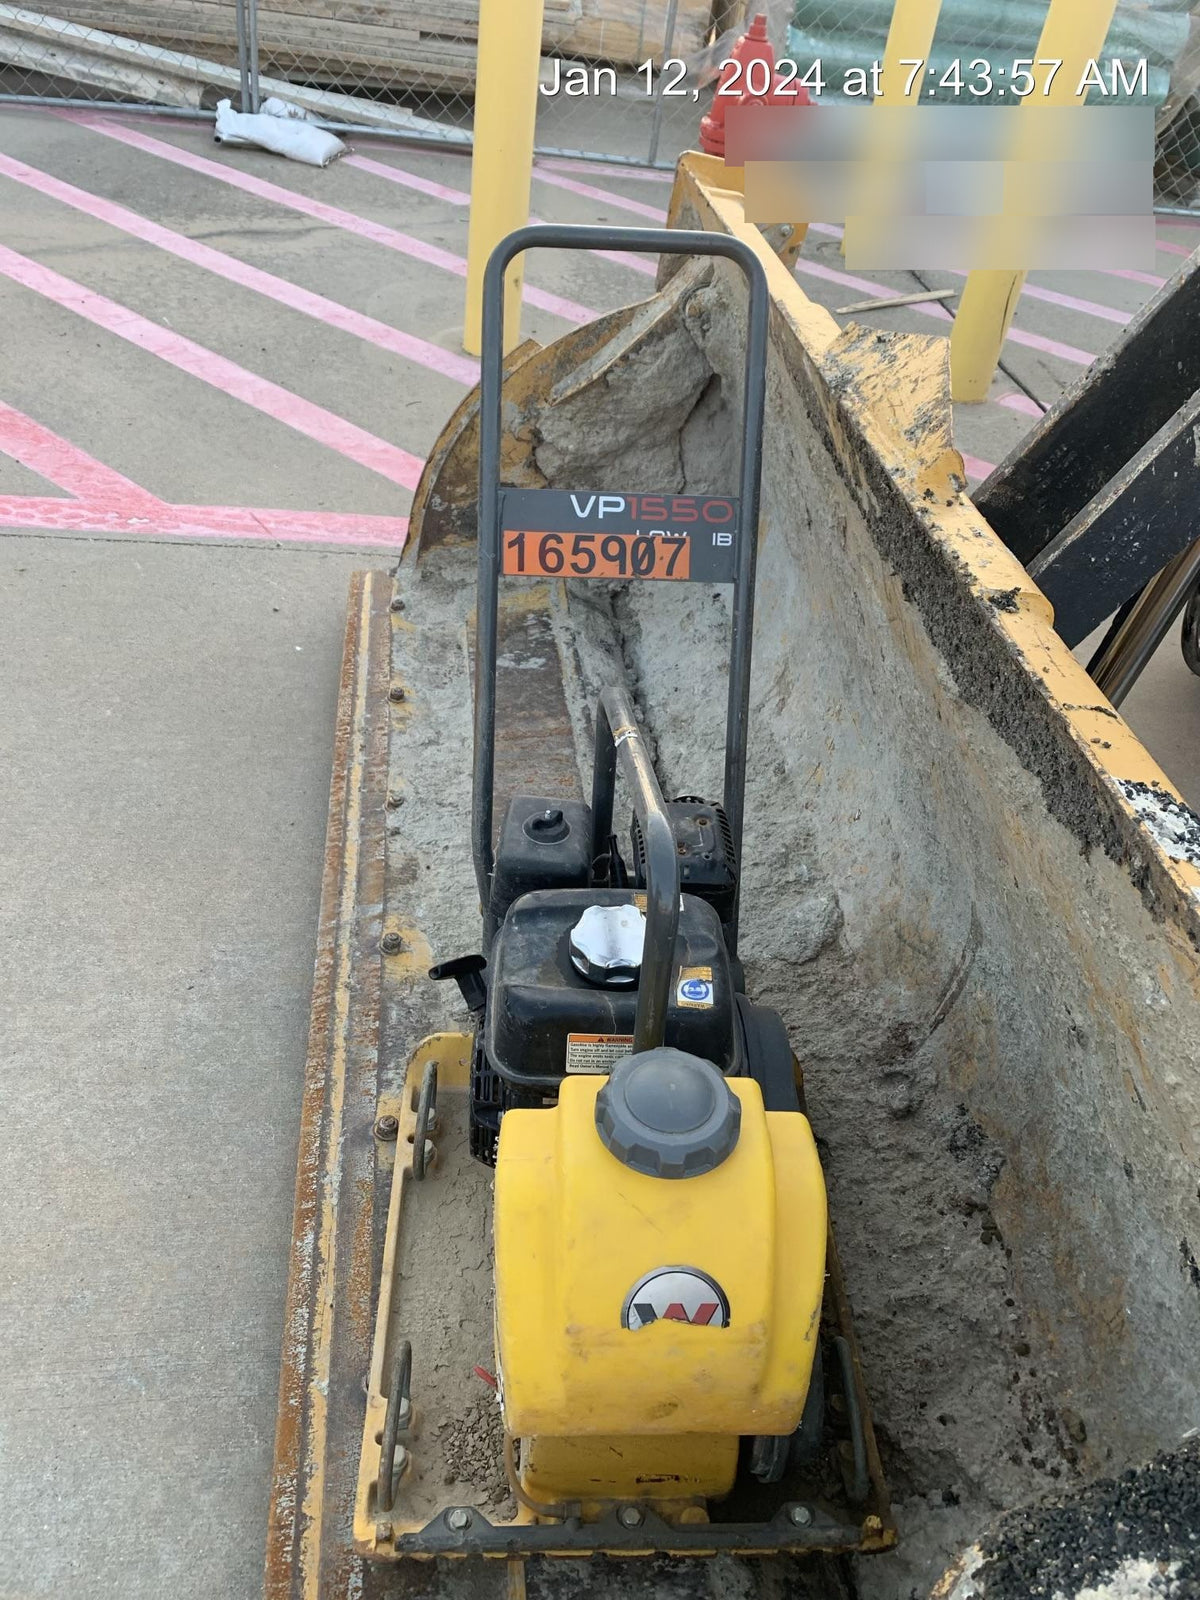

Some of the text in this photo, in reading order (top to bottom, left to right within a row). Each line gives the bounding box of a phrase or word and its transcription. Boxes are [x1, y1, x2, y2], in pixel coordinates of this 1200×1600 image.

[570, 495, 733, 523] VP1550
[712, 532, 732, 546] IB
[508, 533, 686, 576] 165907
